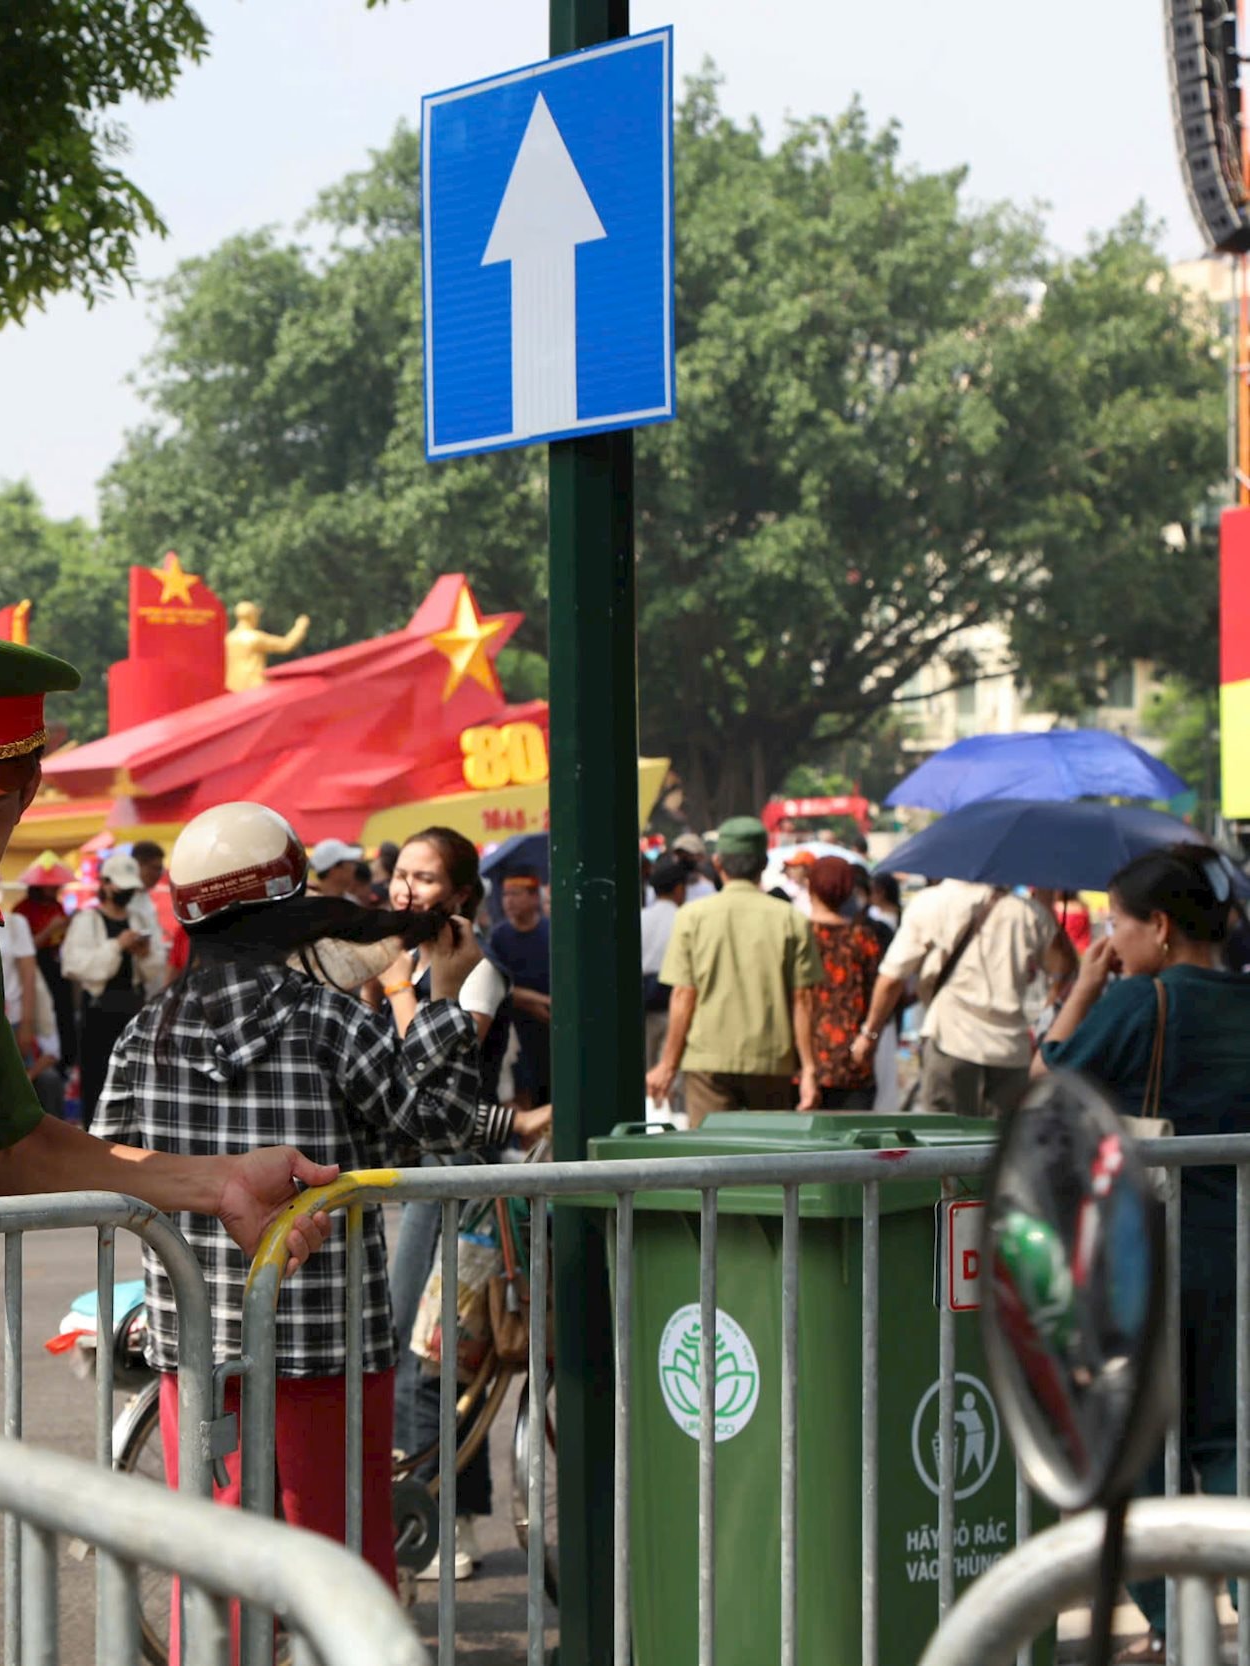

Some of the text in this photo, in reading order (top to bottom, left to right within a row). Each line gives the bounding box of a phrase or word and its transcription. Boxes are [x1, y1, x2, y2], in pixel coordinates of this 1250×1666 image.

[460, 722, 549, 790] 80
[906, 1524, 940, 1552] HÃY
[974, 1516, 1007, 1545] RÁC
[906, 1553, 940, 1582] VÀO
